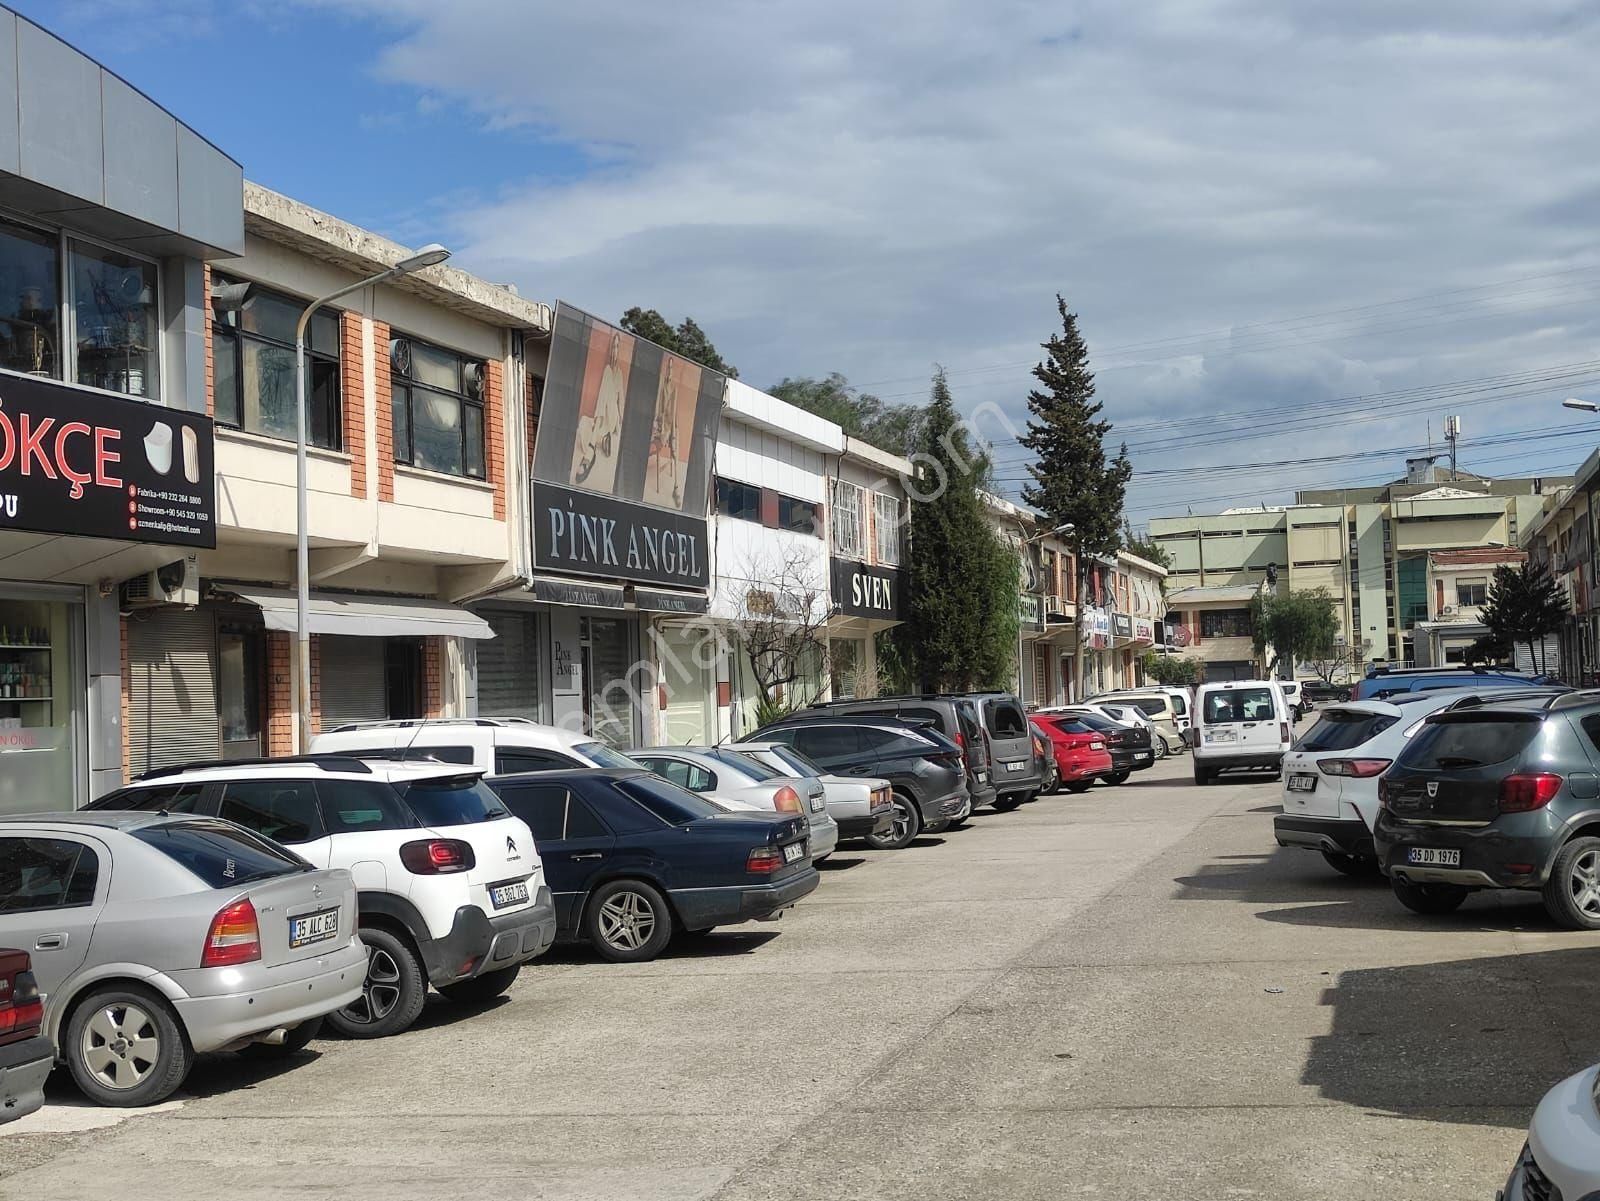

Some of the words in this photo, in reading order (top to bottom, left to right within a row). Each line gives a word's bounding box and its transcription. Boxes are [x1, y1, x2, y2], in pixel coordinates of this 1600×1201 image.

[626, 523, 701, 578] ANGEL
[852, 573, 892, 610] SVEN
[1412, 849, 1422, 861] 35
[1424, 850, 1435, 862] DD
[1438, 850, 1458, 864] 1976
[495, 887, 505, 903] 35
[296, 920, 307, 938] 35
[309, 916, 322, 936] ALC
[324, 912, 336, 931] 628
